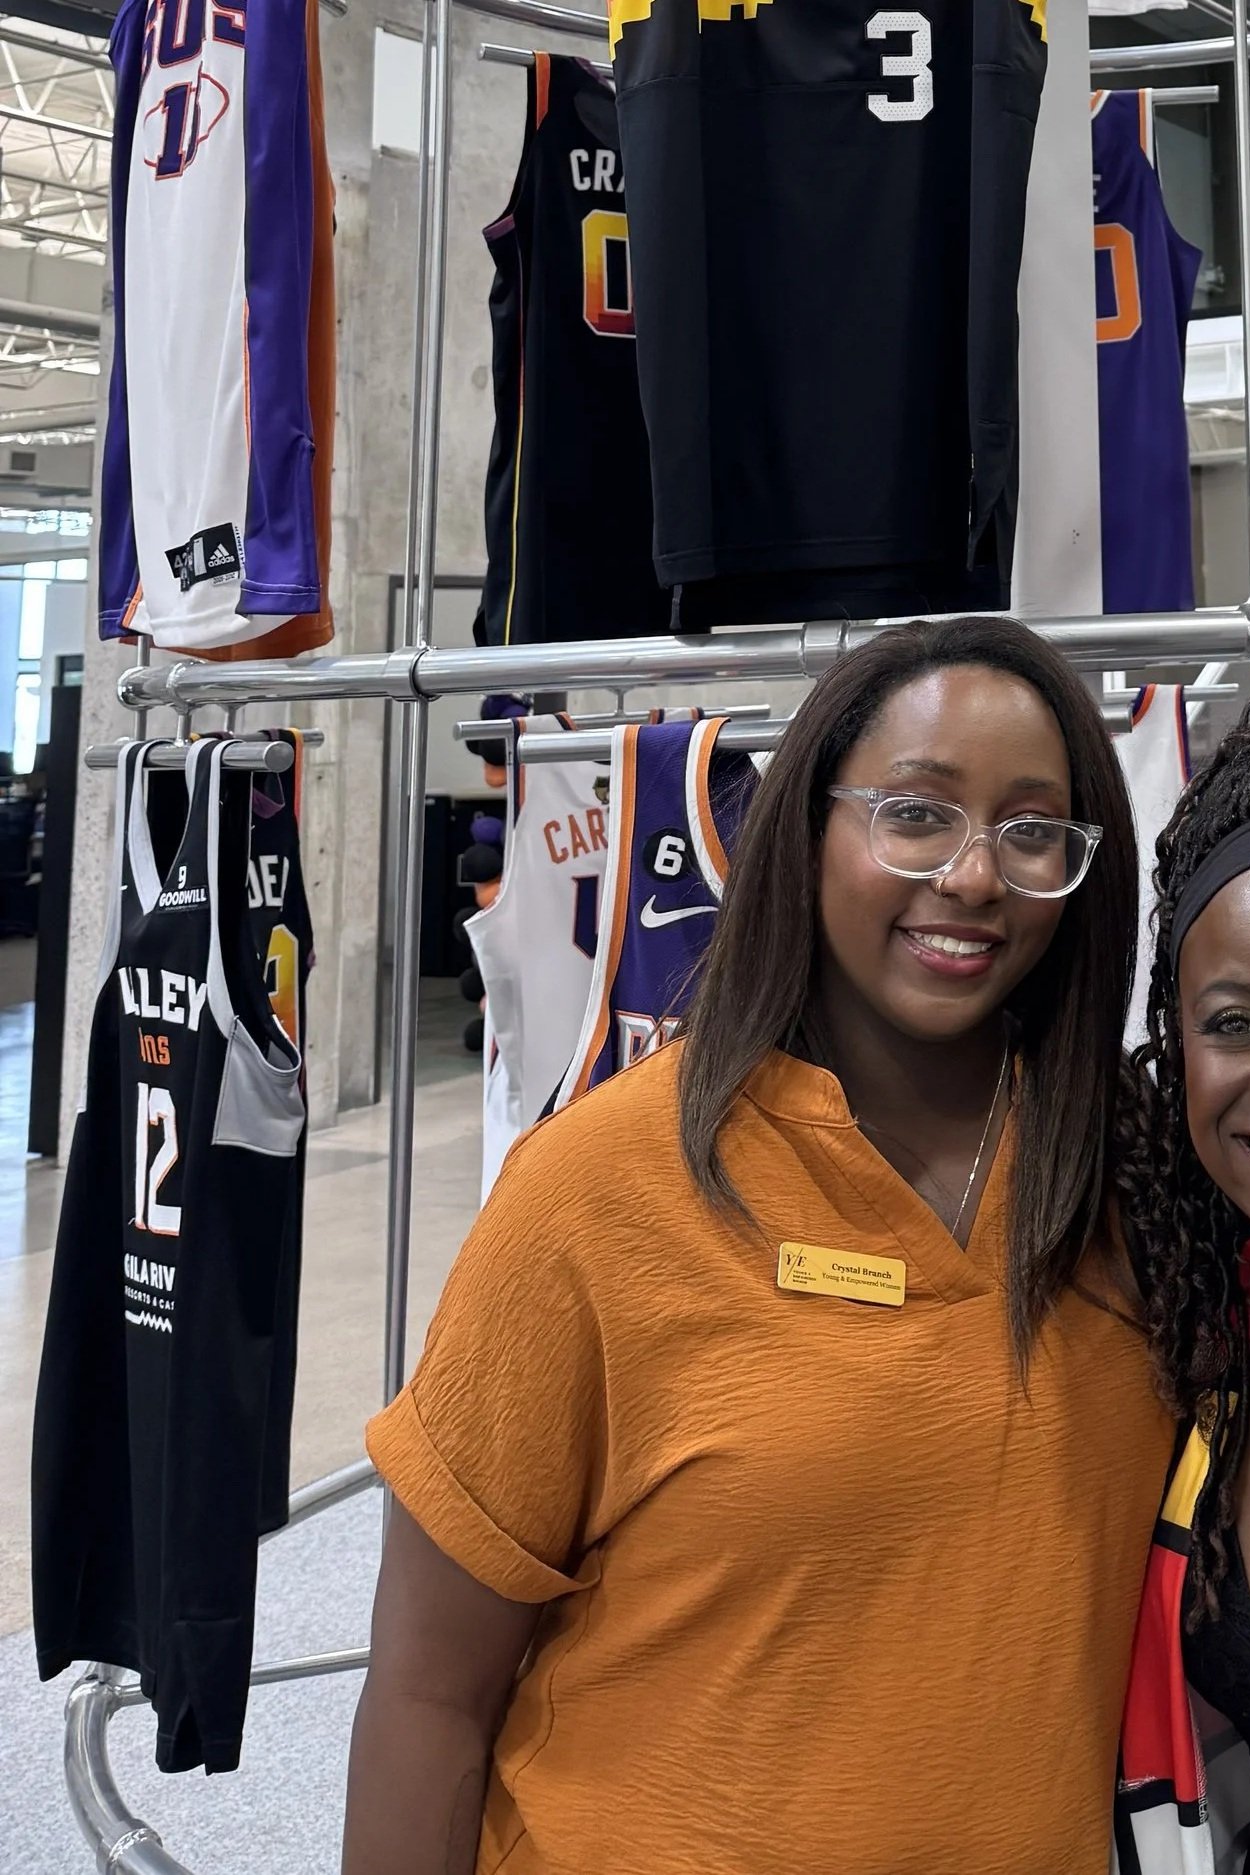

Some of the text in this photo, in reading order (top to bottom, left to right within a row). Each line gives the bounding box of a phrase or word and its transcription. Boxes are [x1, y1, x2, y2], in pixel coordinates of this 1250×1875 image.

[866, 8, 934, 122] 3
[208, 555, 235, 568] adidas
[653, 834, 686, 877] 6
[158, 888, 207, 907] GOODWILL
[134, 1081, 182, 1237] 12
[831, 1263, 893, 1280] Crystal Branch
[846, 1276, 879, 1288] Empowered
